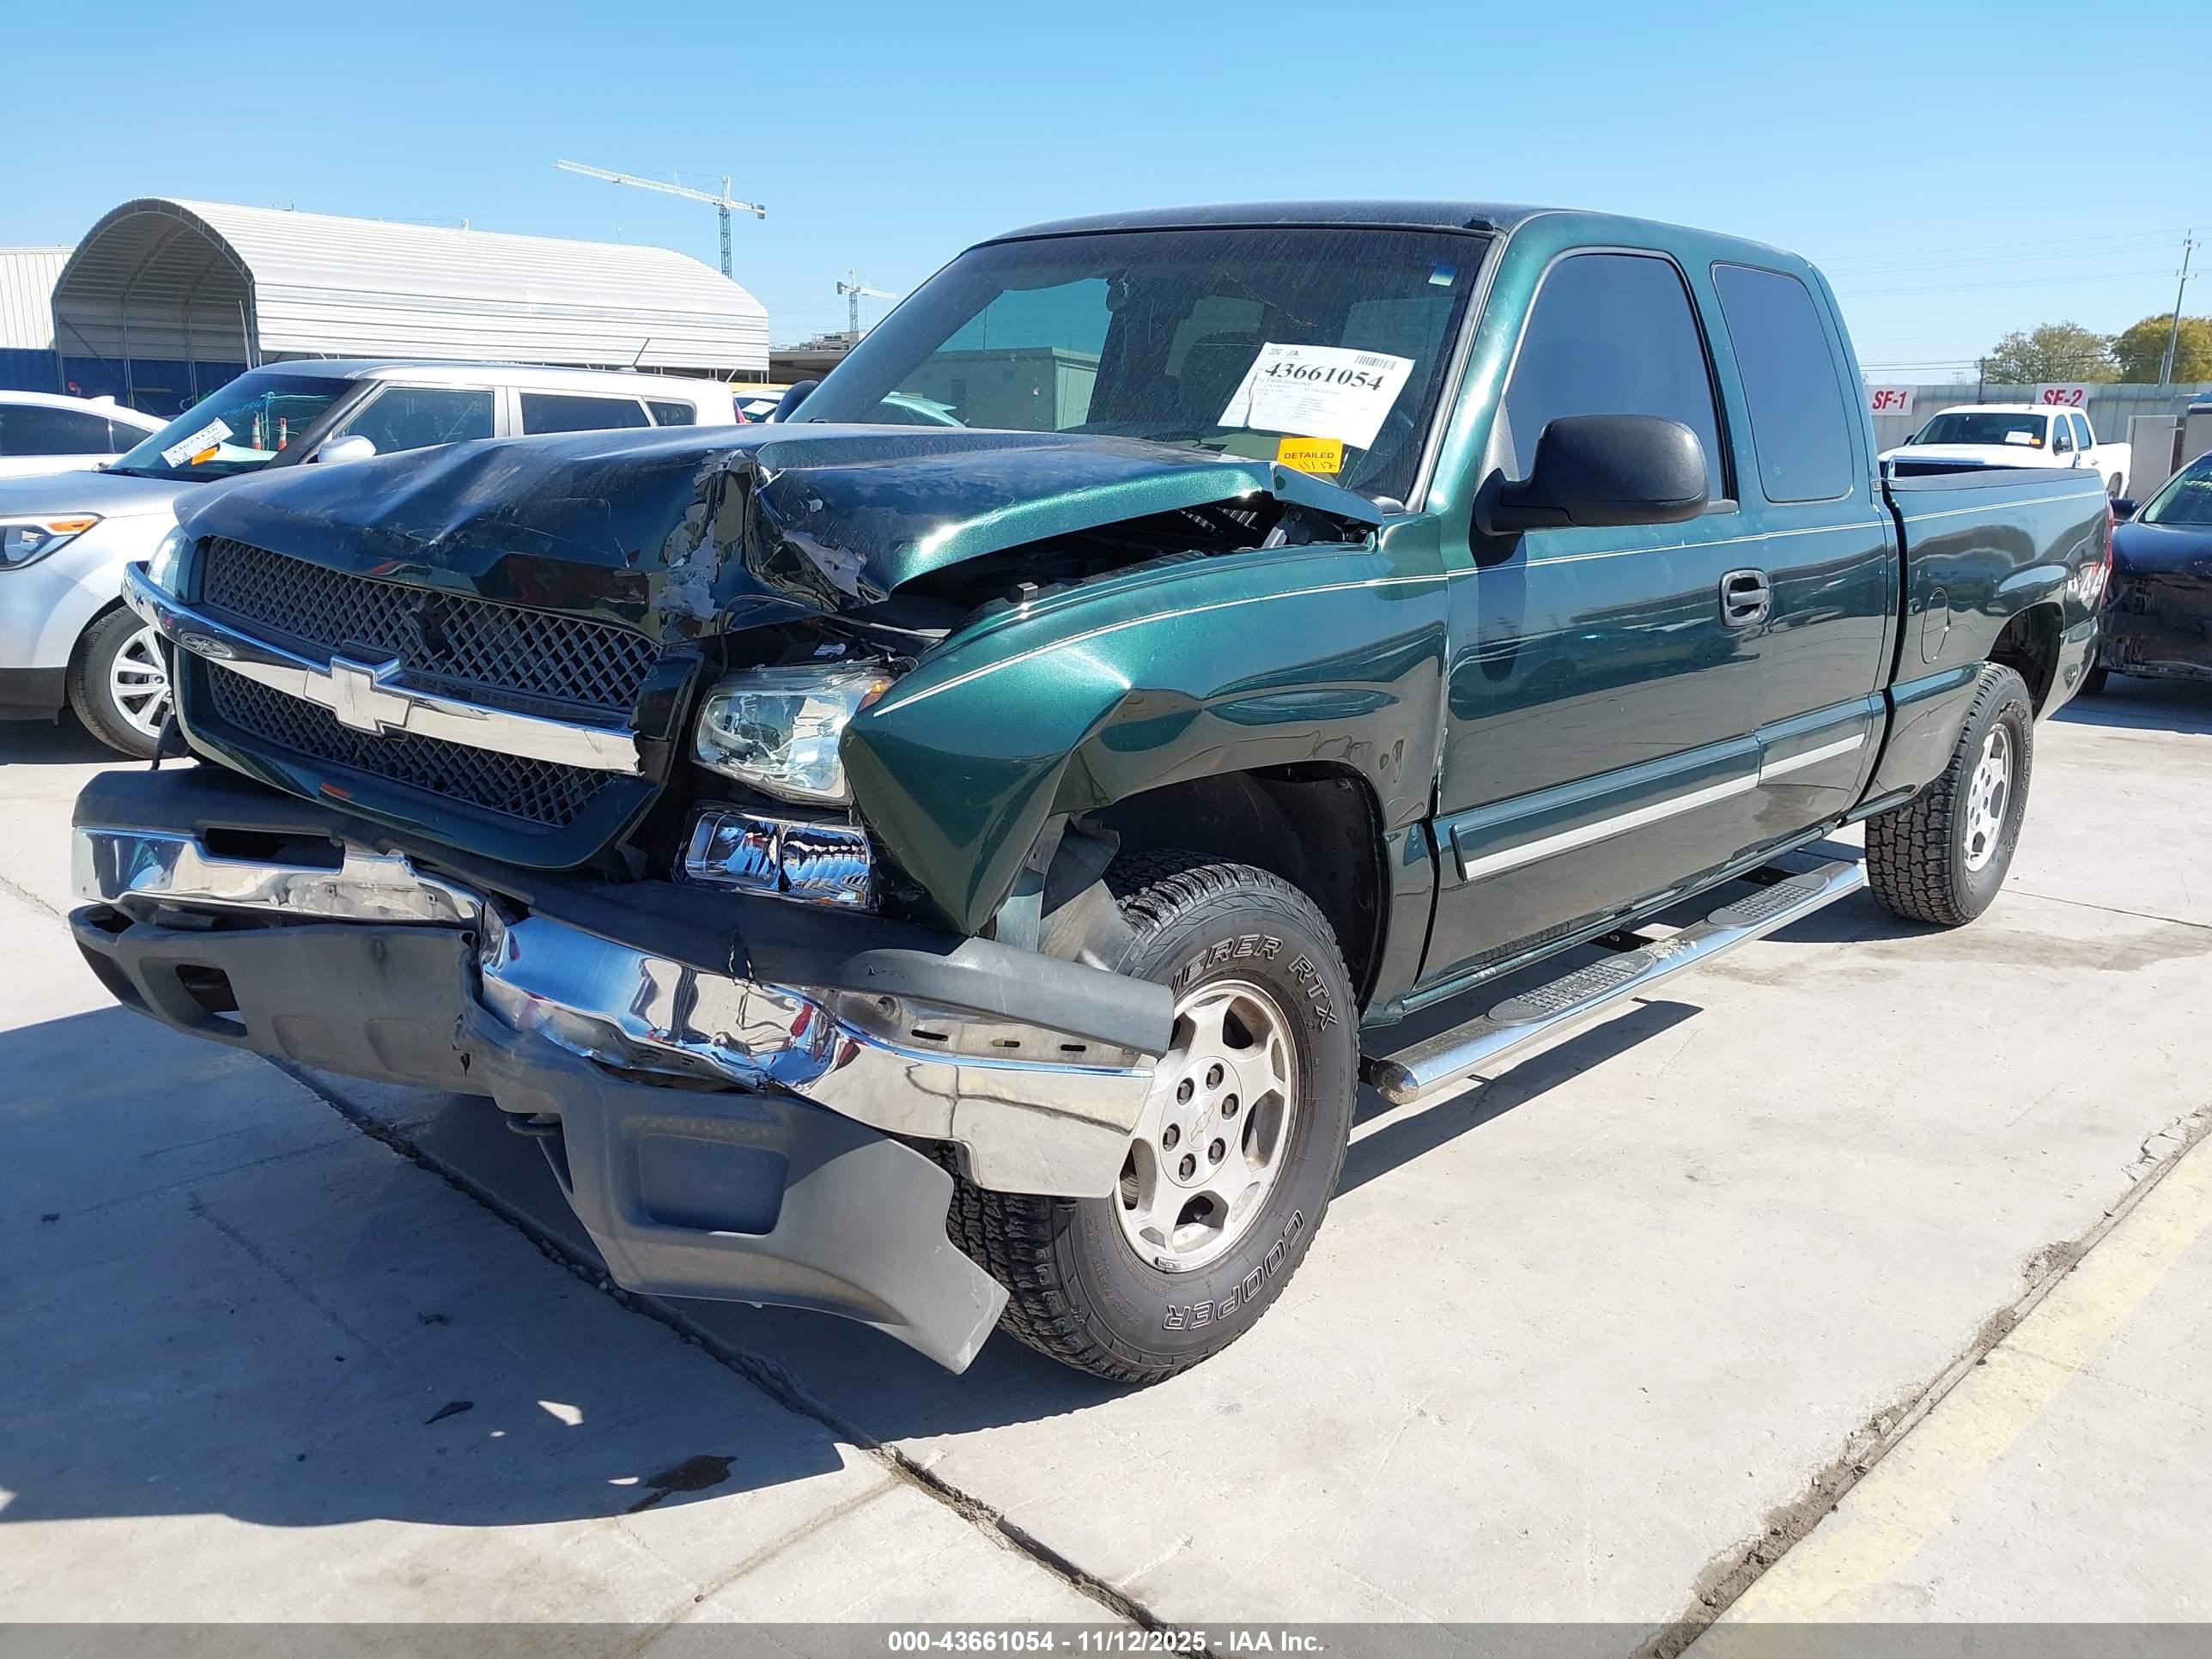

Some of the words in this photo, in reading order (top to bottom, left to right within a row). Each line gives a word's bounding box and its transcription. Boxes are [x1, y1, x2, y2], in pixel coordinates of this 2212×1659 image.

[1264, 362, 1385, 392] 43661054
[1872, 390, 1908, 410] SF-1
[2042, 389, 2083, 407] SF-2
[1287, 952, 1340, 1031] RTX
[1162, 1209, 1305, 1332] COOPER
